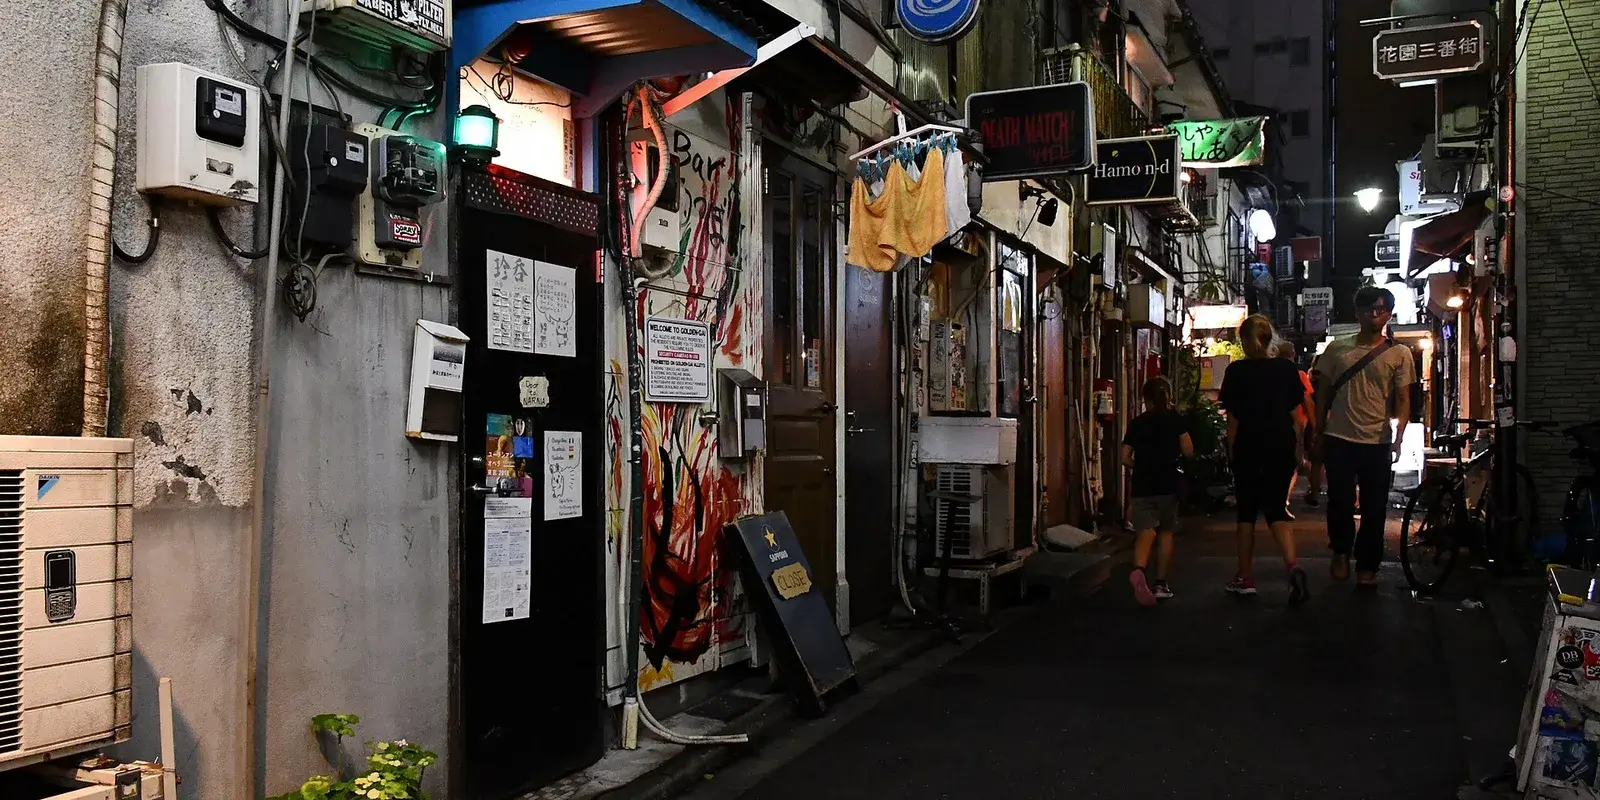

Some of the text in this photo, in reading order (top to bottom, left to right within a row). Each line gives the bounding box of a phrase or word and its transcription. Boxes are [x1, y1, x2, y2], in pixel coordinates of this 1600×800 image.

[357, 0, 392, 19] ABER
[1379, 37, 1478, 63] 花園三番街
[981, 115, 1020, 148] DEATH
[674, 129, 725, 182] Bar
[650, 324, 706, 337] WELCOME TO GOLDEN-GAI
[769, 549, 789, 563] SAPPORO
[777, 570, 807, 591] CLOSE
[1562, 650, 1579, 661] DB
